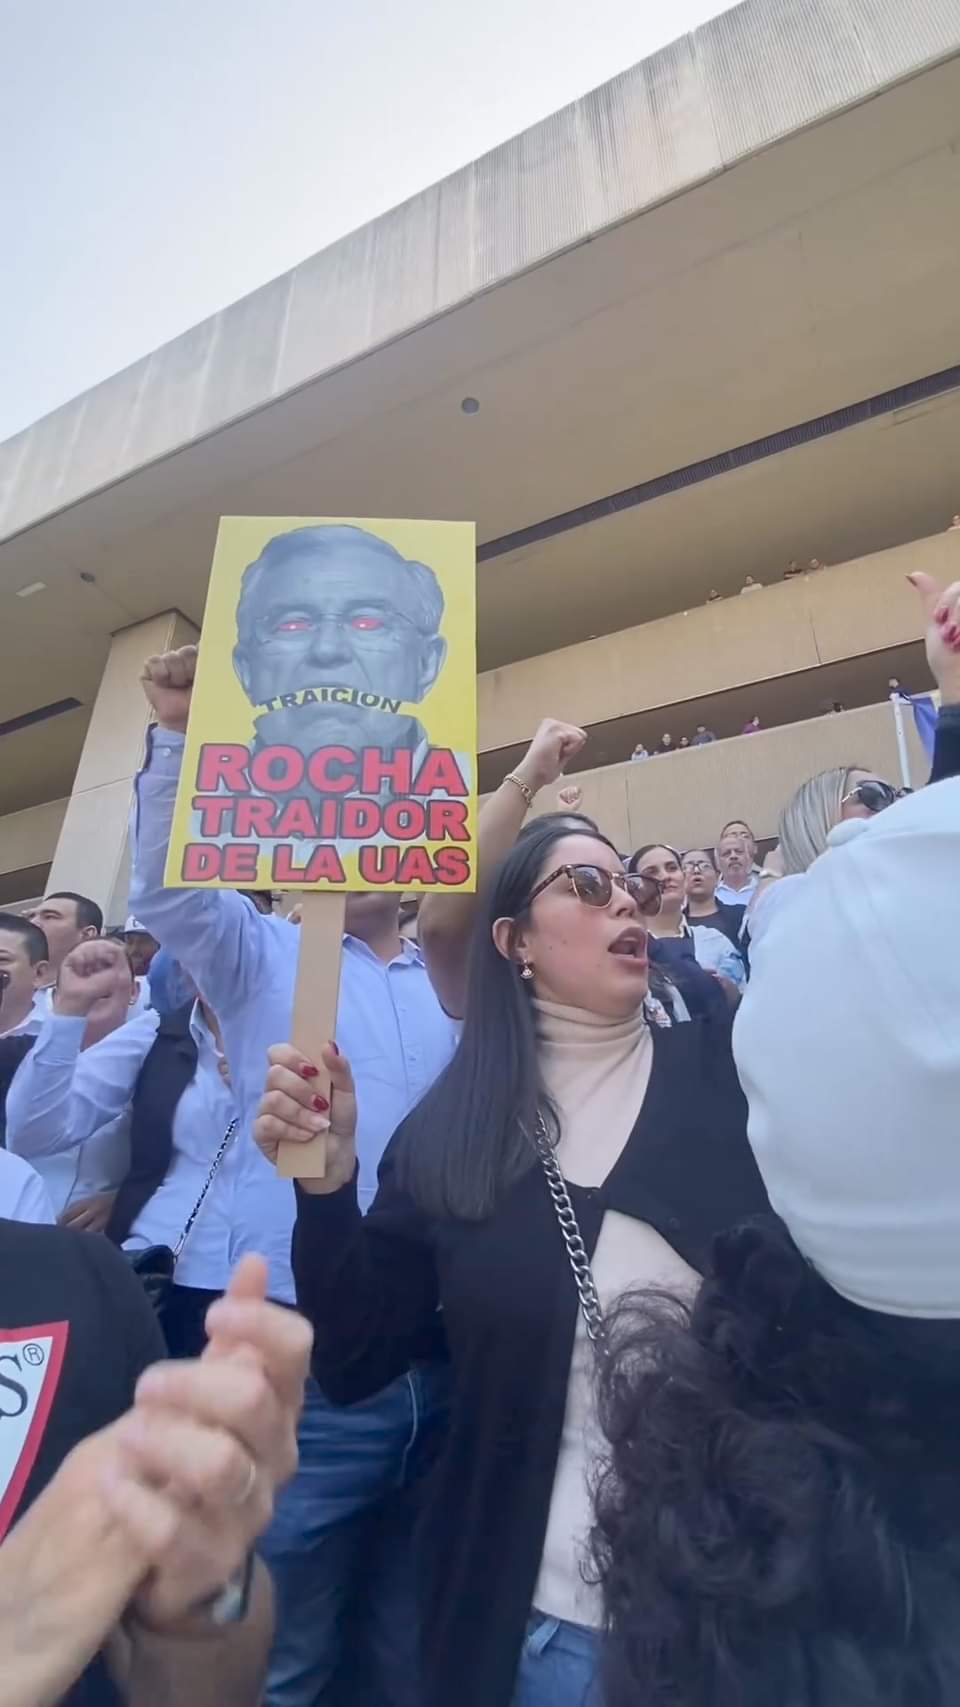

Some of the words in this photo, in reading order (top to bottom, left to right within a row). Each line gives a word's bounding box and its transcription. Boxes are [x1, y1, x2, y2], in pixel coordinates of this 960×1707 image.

[258, 687, 401, 714] TRAICION
[196, 743, 469, 796] ROCHA
[192, 795, 471, 841] TRAIDOR
[181, 843, 260, 882] DE
[271, 843, 346, 884] LA
[358, 845, 471, 885] UAS
